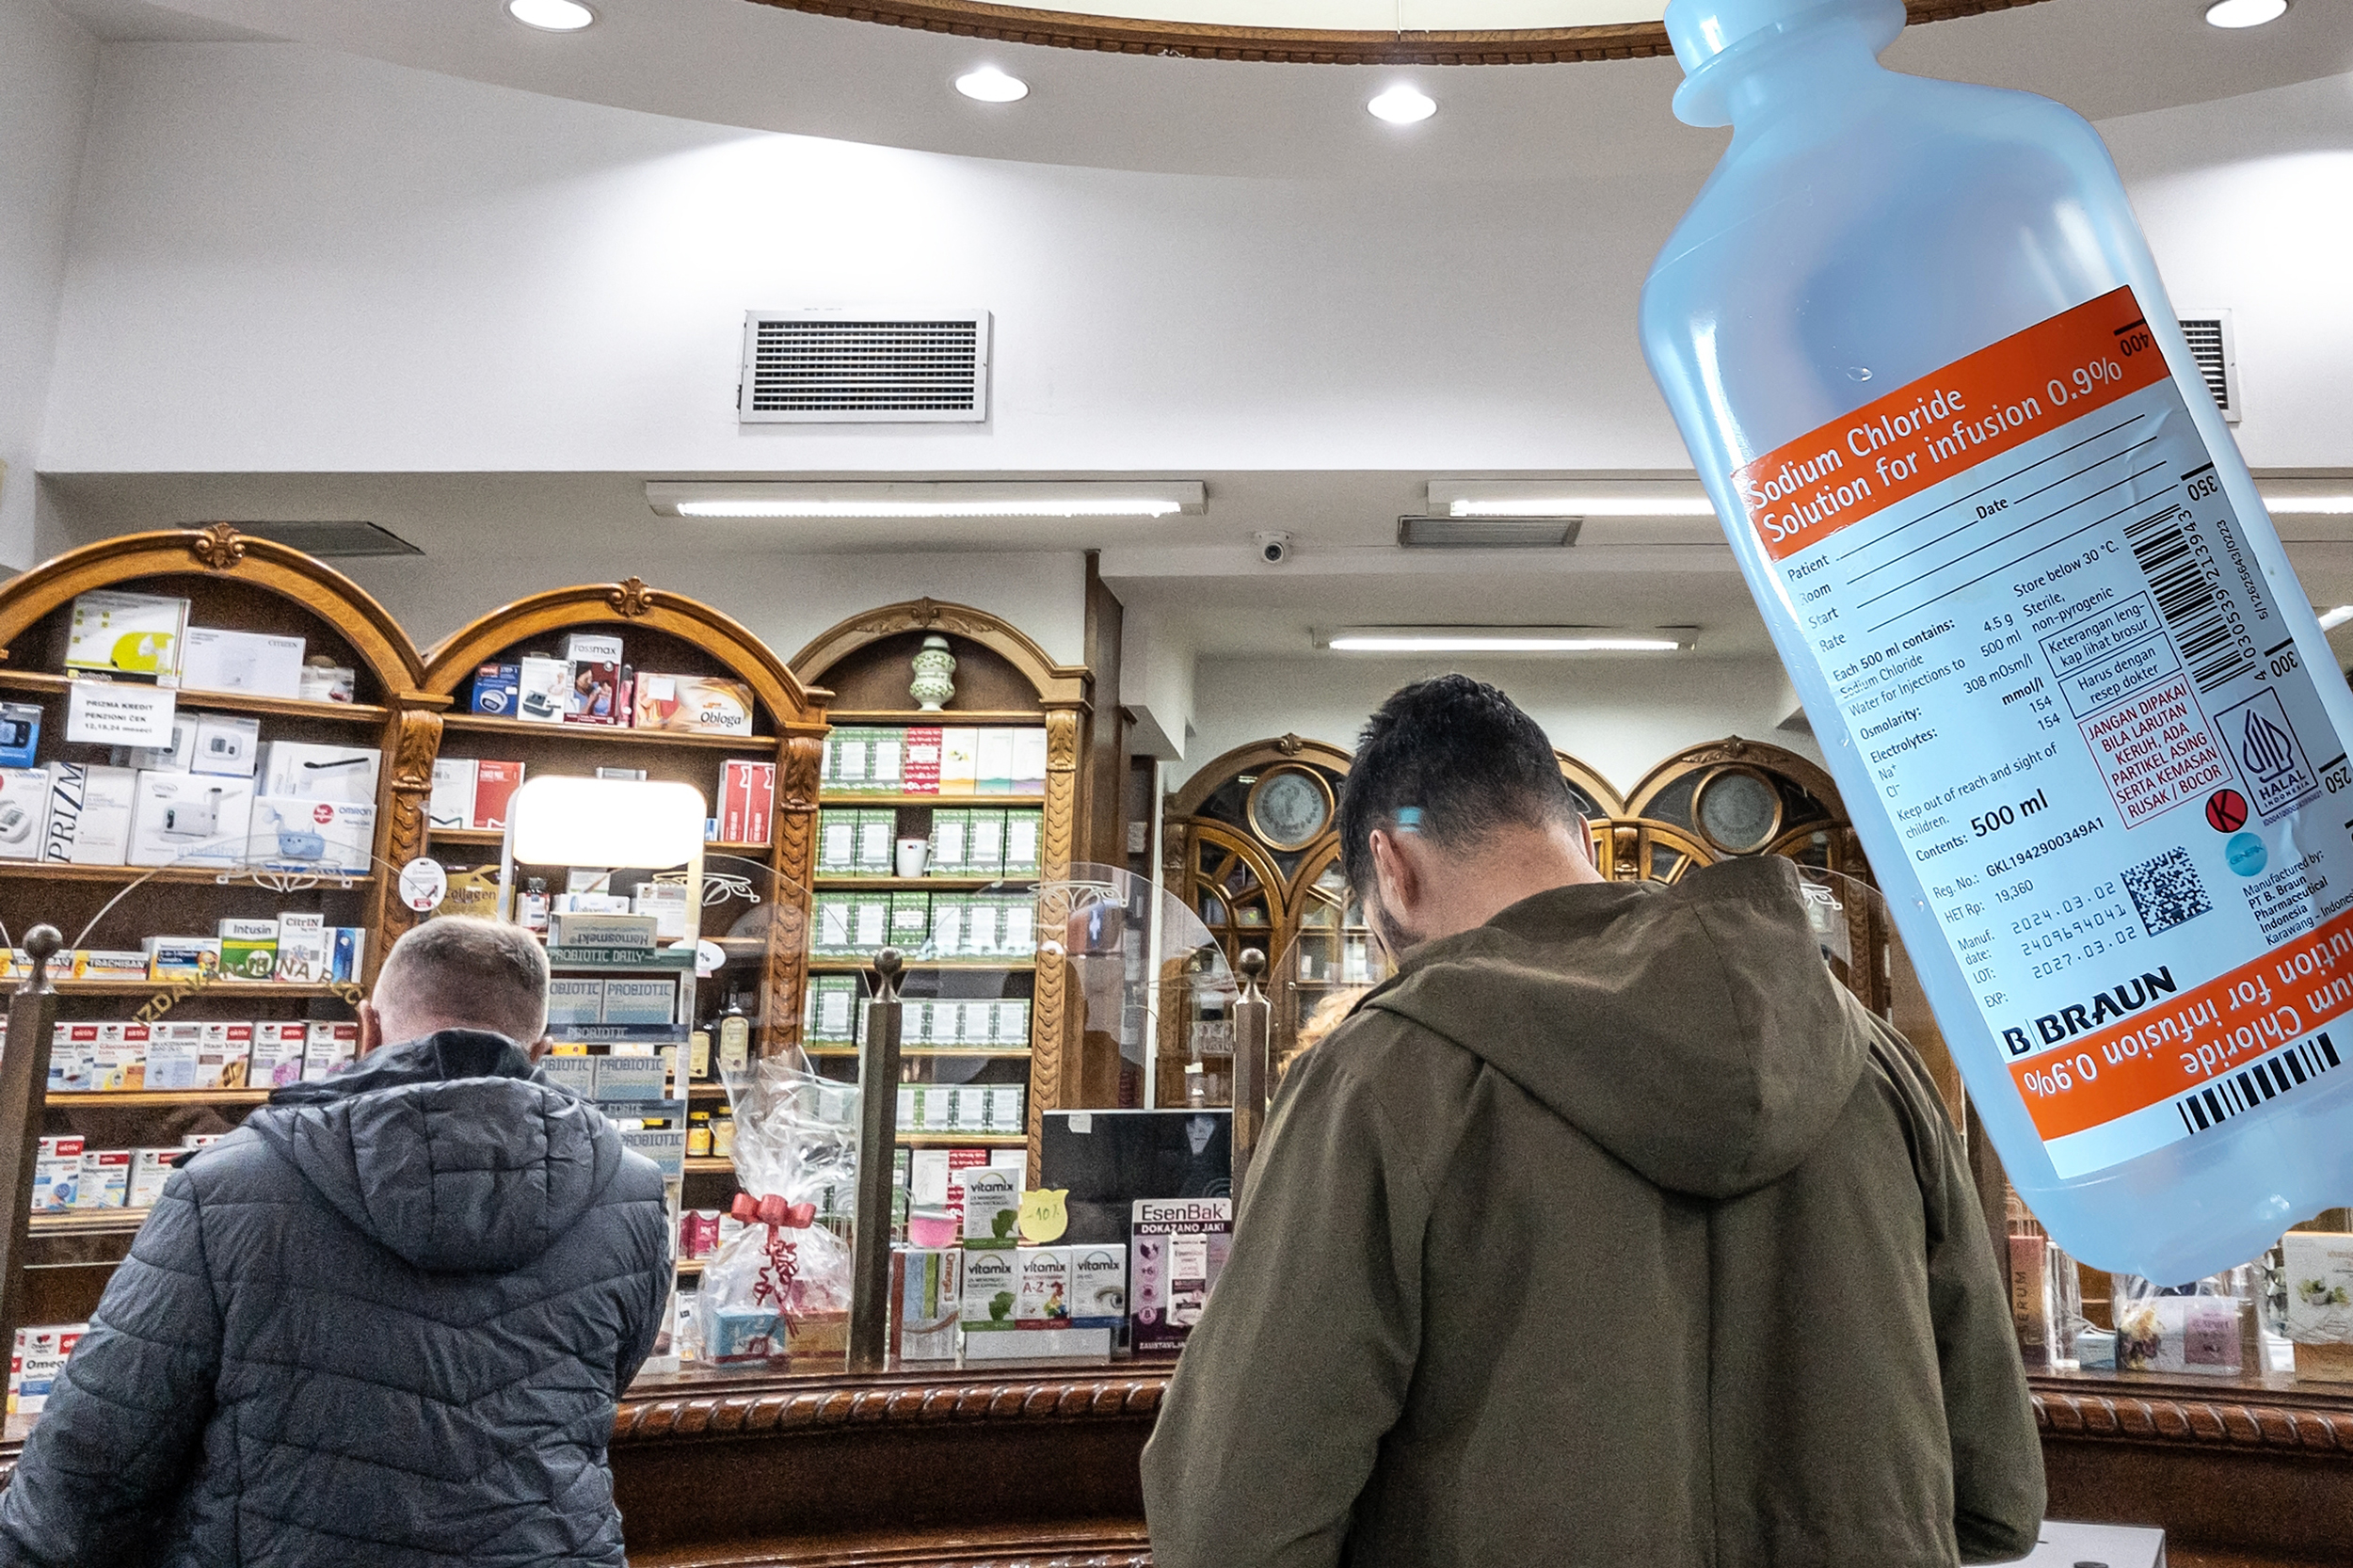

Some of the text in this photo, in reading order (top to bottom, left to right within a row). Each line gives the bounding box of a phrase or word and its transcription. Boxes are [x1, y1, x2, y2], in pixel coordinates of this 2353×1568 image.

[2121, 330, 2150, 358] 400
[1748, 389, 1966, 510] Sodium Chloride
[1763, 357, 2123, 544] Solution for infusion 0.9%
[2186, 474, 2219, 502] 350
[1976, 497, 2009, 520] Date
[1787, 554, 1830, 582] Patient
[2013, 577, 2046, 598] Store
[2046, 558, 2082, 581] below
[2083, 550, 2100, 567] 30
[1800, 584, 1832, 605] Room
[2023, 591, 2066, 617] Sterile,
[2032, 585, 2115, 633] non-pyrogenic
[1809, 607, 1839, 629] Start
[1983, 614, 2014, 632] 4.5 g
[2048, 604, 2145, 654] Keterangan leng-
[574, 644, 616, 656] rossmax
[1819, 632, 1847, 652] Rate
[1833, 619, 1955, 681] Each 500 ml contains:
[1980, 630, 2023, 658] 500 ml
[2059, 617, 2149, 667] kap lihat brosur
[1840, 653, 1925, 698] Sodium Chloride
[1963, 653, 2034, 694] 308 mOsm/l
[2077, 647, 2156, 691] Harus dengan
[2270, 650, 2299, 679] 300
[1849, 658, 1966, 716] Water for Injections to
[2002, 677, 2044, 705] mmol/l
[2090, 663, 2159, 704] resep dokter
[85, 712, 126, 722] PENZIONI
[86, 699, 153, 712] PRIZMA KREDIT
[2029, 696, 2053, 713] 154
[2089, 683, 2187, 741] JANGAN DIPAKAI
[700, 712, 741, 728] Obloga
[1860, 707, 1922, 740] Osmolarity:
[2037, 712, 2061, 731] 154
[2102, 702, 2188, 753] BILA LARUTAN
[1870, 728, 1938, 764] Electrolytes:
[2111, 731, 2207, 786] PARTIKEL ASING
[2115, 722, 2189, 765] KERUH, ADA
[1897, 742, 2058, 822] Keep out of reach and sight of
[2117, 746, 2217, 804] SERTA KEMASAN
[2259, 770, 2306, 800] HALAL
[2325, 766, 2352, 793] 250
[2128, 764, 2223, 819] RUSAK BOCOR
[2265, 781, 2309, 808] INDONESIA
[1916, 788, 2049, 862] Contents: 500 ml
[2210, 791, 2245, 832] K
[1905, 816, 1950, 840] children.
[1932, 816, 2105, 900] Reg. No.: GKL1942900349A1
[2243, 850, 2325, 898] Manufactured by:
[1945, 879, 2034, 923] HET Rp: 19,360
[2248, 875, 2308, 910] PT B. Braun
[2253, 875, 2329, 921] Pharmaceutical
[233, 924, 272, 935] Intusin
[1958, 881, 2117, 951] Manuf. 2024.03.02
[2260, 904, 2309, 934] Indonesia
[2265, 888, 2353, 946] Karawang Indones
[613, 950, 642, 962] DAILY
[1965, 949, 1993, 966] date:
[1973, 904, 2127, 984] LOT: 2409694041
[1984, 925, 2137, 1008] EXP: 2027.03.02
[549, 983, 600, 996] OBIOTIC
[607, 983, 671, 996] PROBIOTIC
[2228, 973, 2272, 1013] for
[2034, 965, 2179, 1046] BRAUN
[567, 1027, 628, 1038] PROBIOTIC
[2101, 998, 2219, 1066] infusion
[2179, 1004, 2303, 1078] Chloride
[541, 1059, 590, 1071] OBIOTIC
[600, 1059, 664, 1071] PROBIOTIC
[2024, 1052, 2098, 1097] 0.9%
[621, 1133, 681, 1146] PROBIOTIC
[970, 1182, 1014, 1192] vitamix
[1142, 1204, 1225, 1222] EsenBak
[1142, 1224, 1199, 1233] DOKAZANO
[968, 1263, 1012, 1274] vitamix
[1023, 1261, 1066, 1272] vitamix
[1077, 1259, 1120, 1271] vitamix
[1022, 1281, 1045, 1294] A-Z
